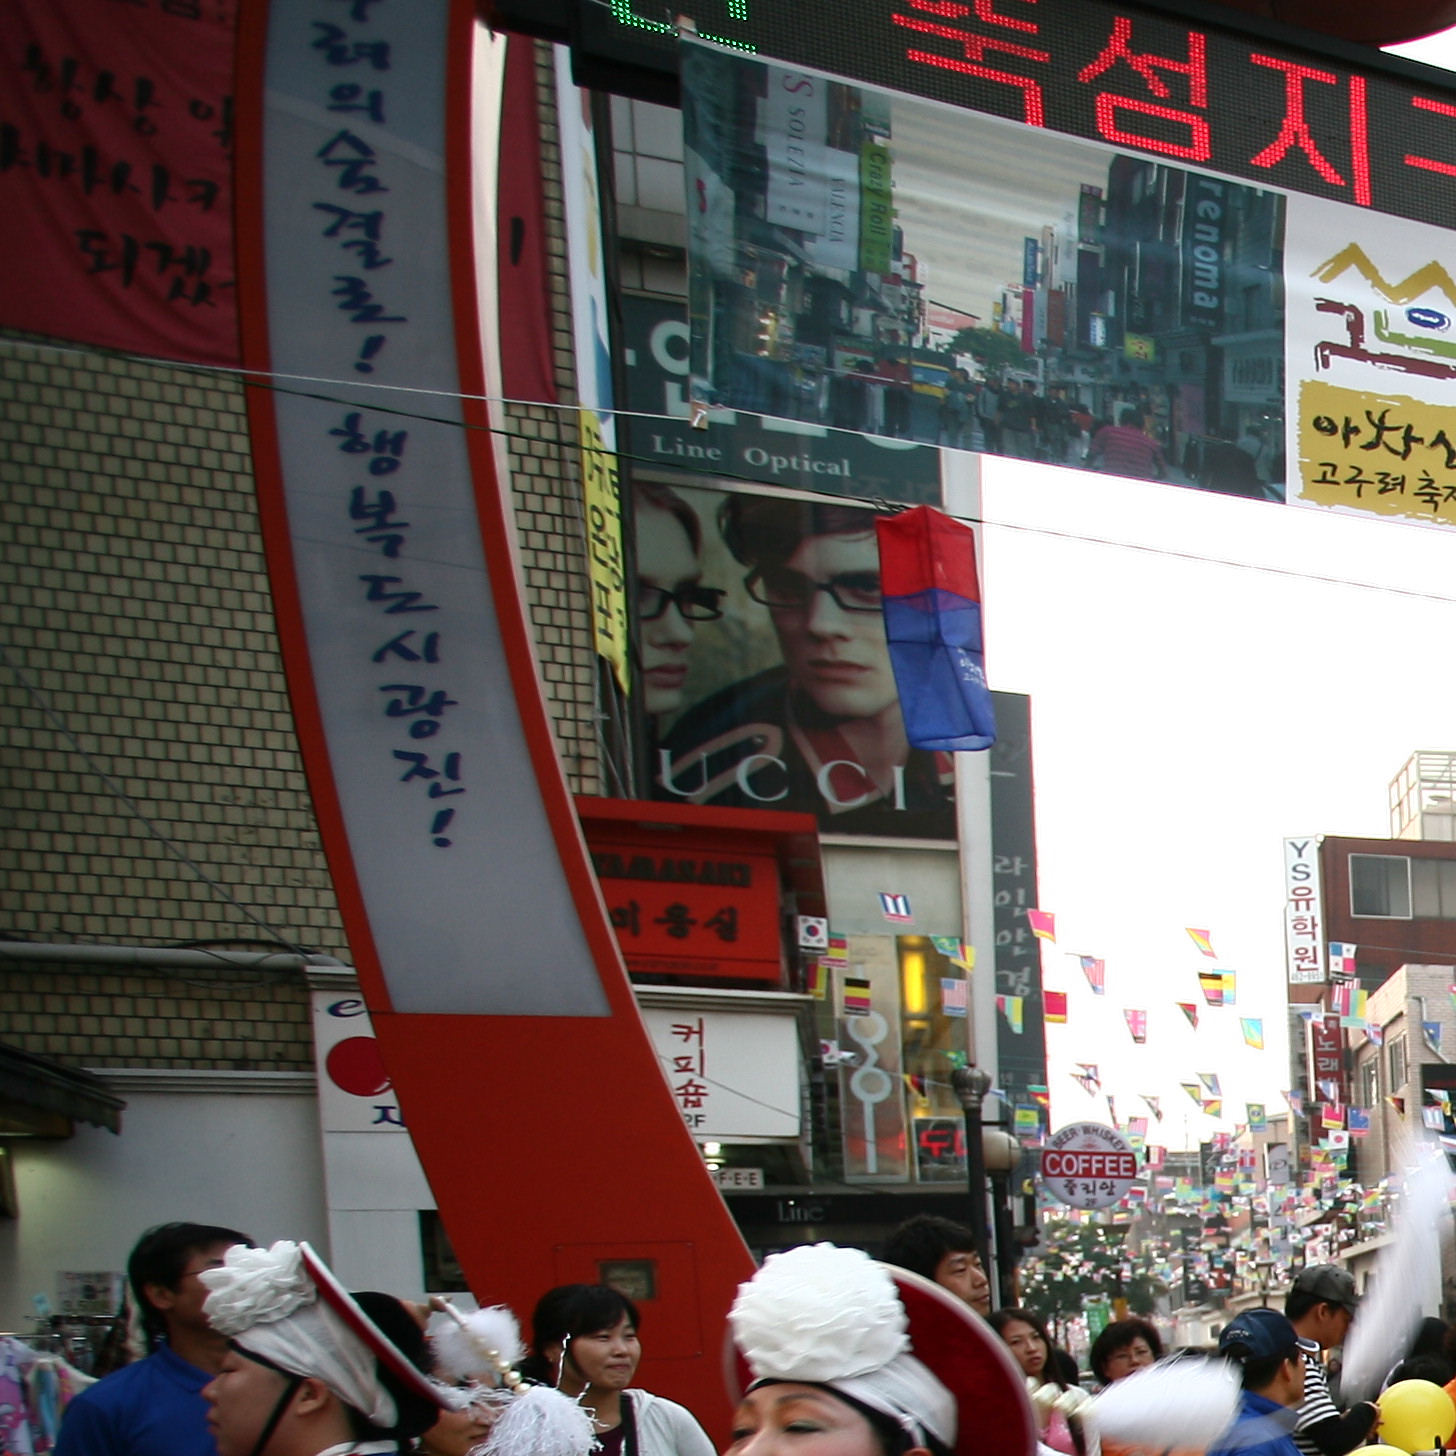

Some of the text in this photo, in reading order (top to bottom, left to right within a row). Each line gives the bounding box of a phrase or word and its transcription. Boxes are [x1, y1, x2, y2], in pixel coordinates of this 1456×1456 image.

[652, 434, 853, 478] Line Optical
[1311, 460, 1406, 497] 고구려
[656, 748, 909, 812] UCCI
[670, 1016, 709, 1109] 커피숍
[1052, 1127, 1079, 1149] BEER
[1044, 1153, 1134, 1177] COFFEE
